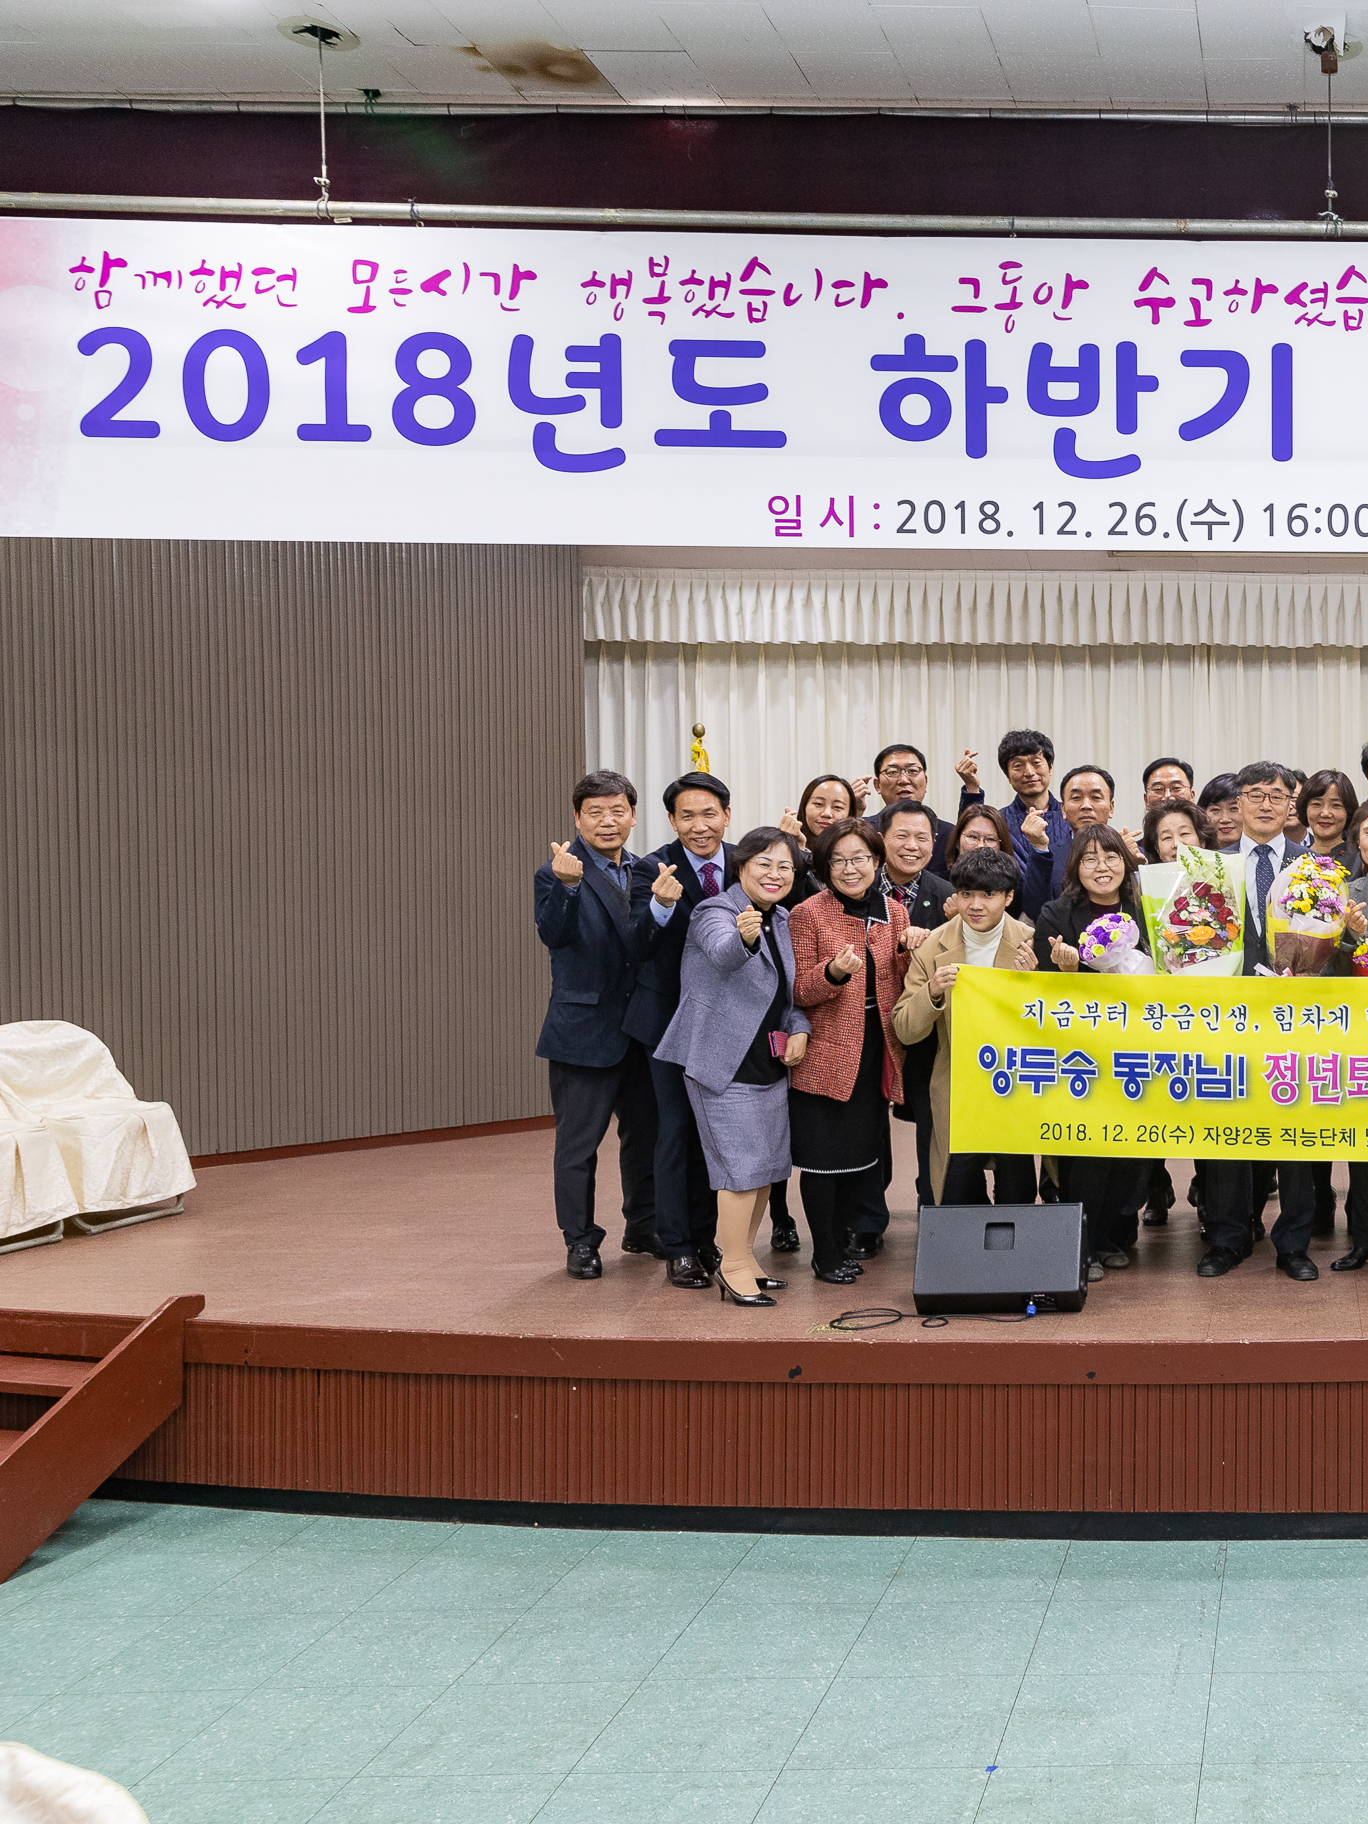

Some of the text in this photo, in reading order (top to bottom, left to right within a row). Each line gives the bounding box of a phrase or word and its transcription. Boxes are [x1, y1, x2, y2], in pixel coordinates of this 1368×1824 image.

[69, 251, 297, 309] 함께했던
[581, 256, 904, 324] 행복했습니다.
[951, 261, 1089, 333] 그동안
[78, 327, 786, 472] 2018년도
[871, 334, 1292, 479] 하반기
[1025, 1000, 1126, 1027] 지금부터
[1143, 1004, 1258, 1031] 황금인생,
[1273, 1005, 1348, 1031] 힘차게
[979, 1046, 1096, 1097] 양두승
[1114, 1053, 1244, 1100] 동장님!
[1137, 1125, 1194, 1144] 26(수)
[1203, 1126, 1272, 1146] 자양2동
[1280, 1128, 1355, 1147] 직능단체
